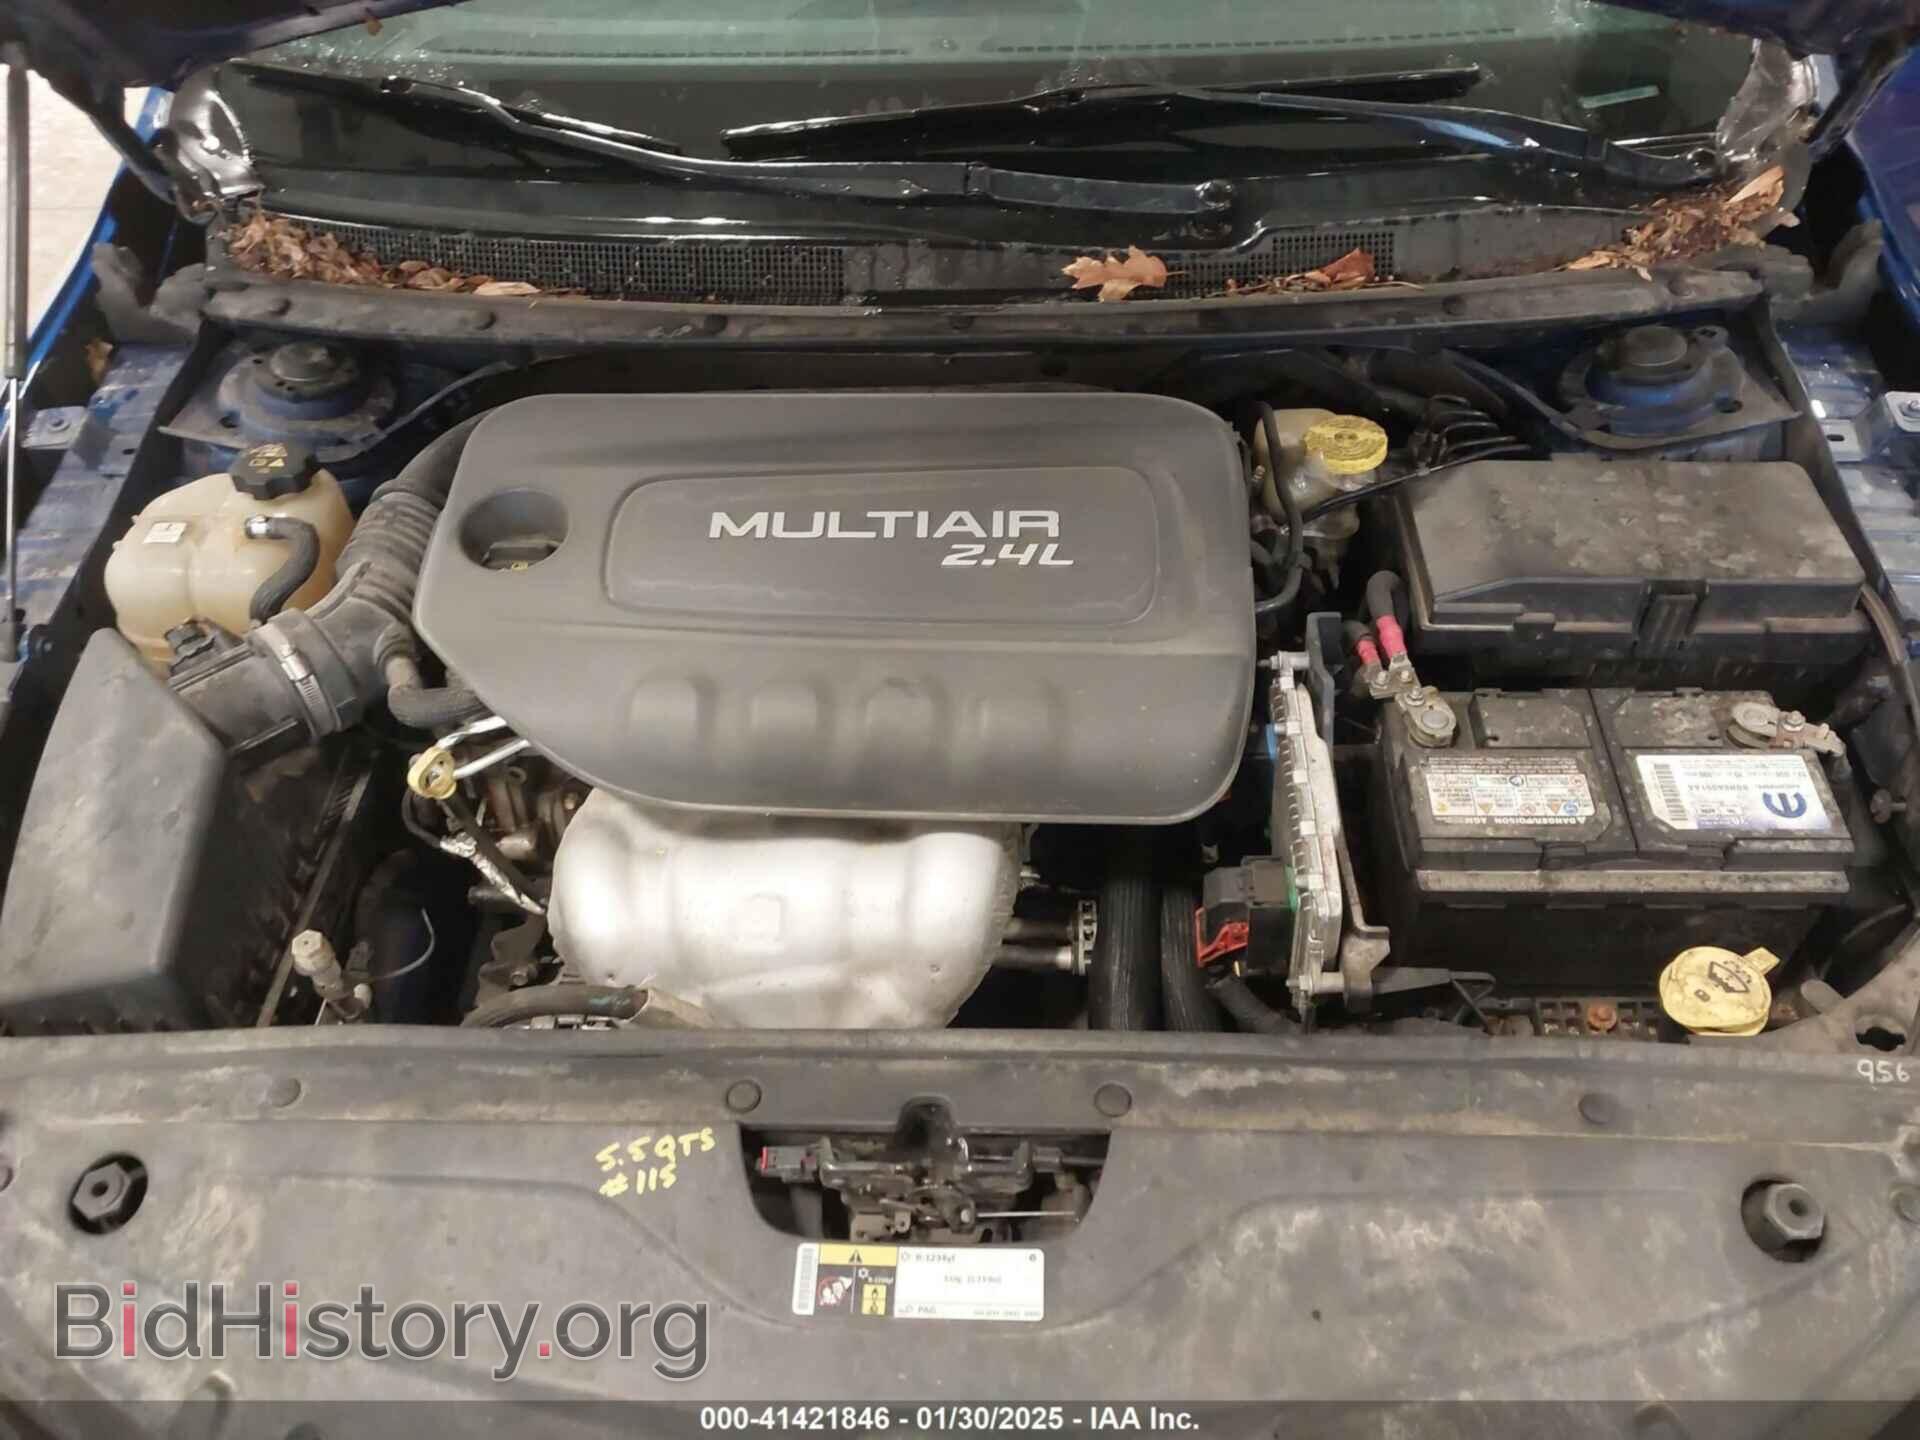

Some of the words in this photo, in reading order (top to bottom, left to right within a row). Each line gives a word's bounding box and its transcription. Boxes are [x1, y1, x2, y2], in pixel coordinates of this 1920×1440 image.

[709, 510, 1060, 539] MULTIAIR
[941, 543, 1074, 567] 2.4L
[1857, 1059, 1910, 1084] 956
